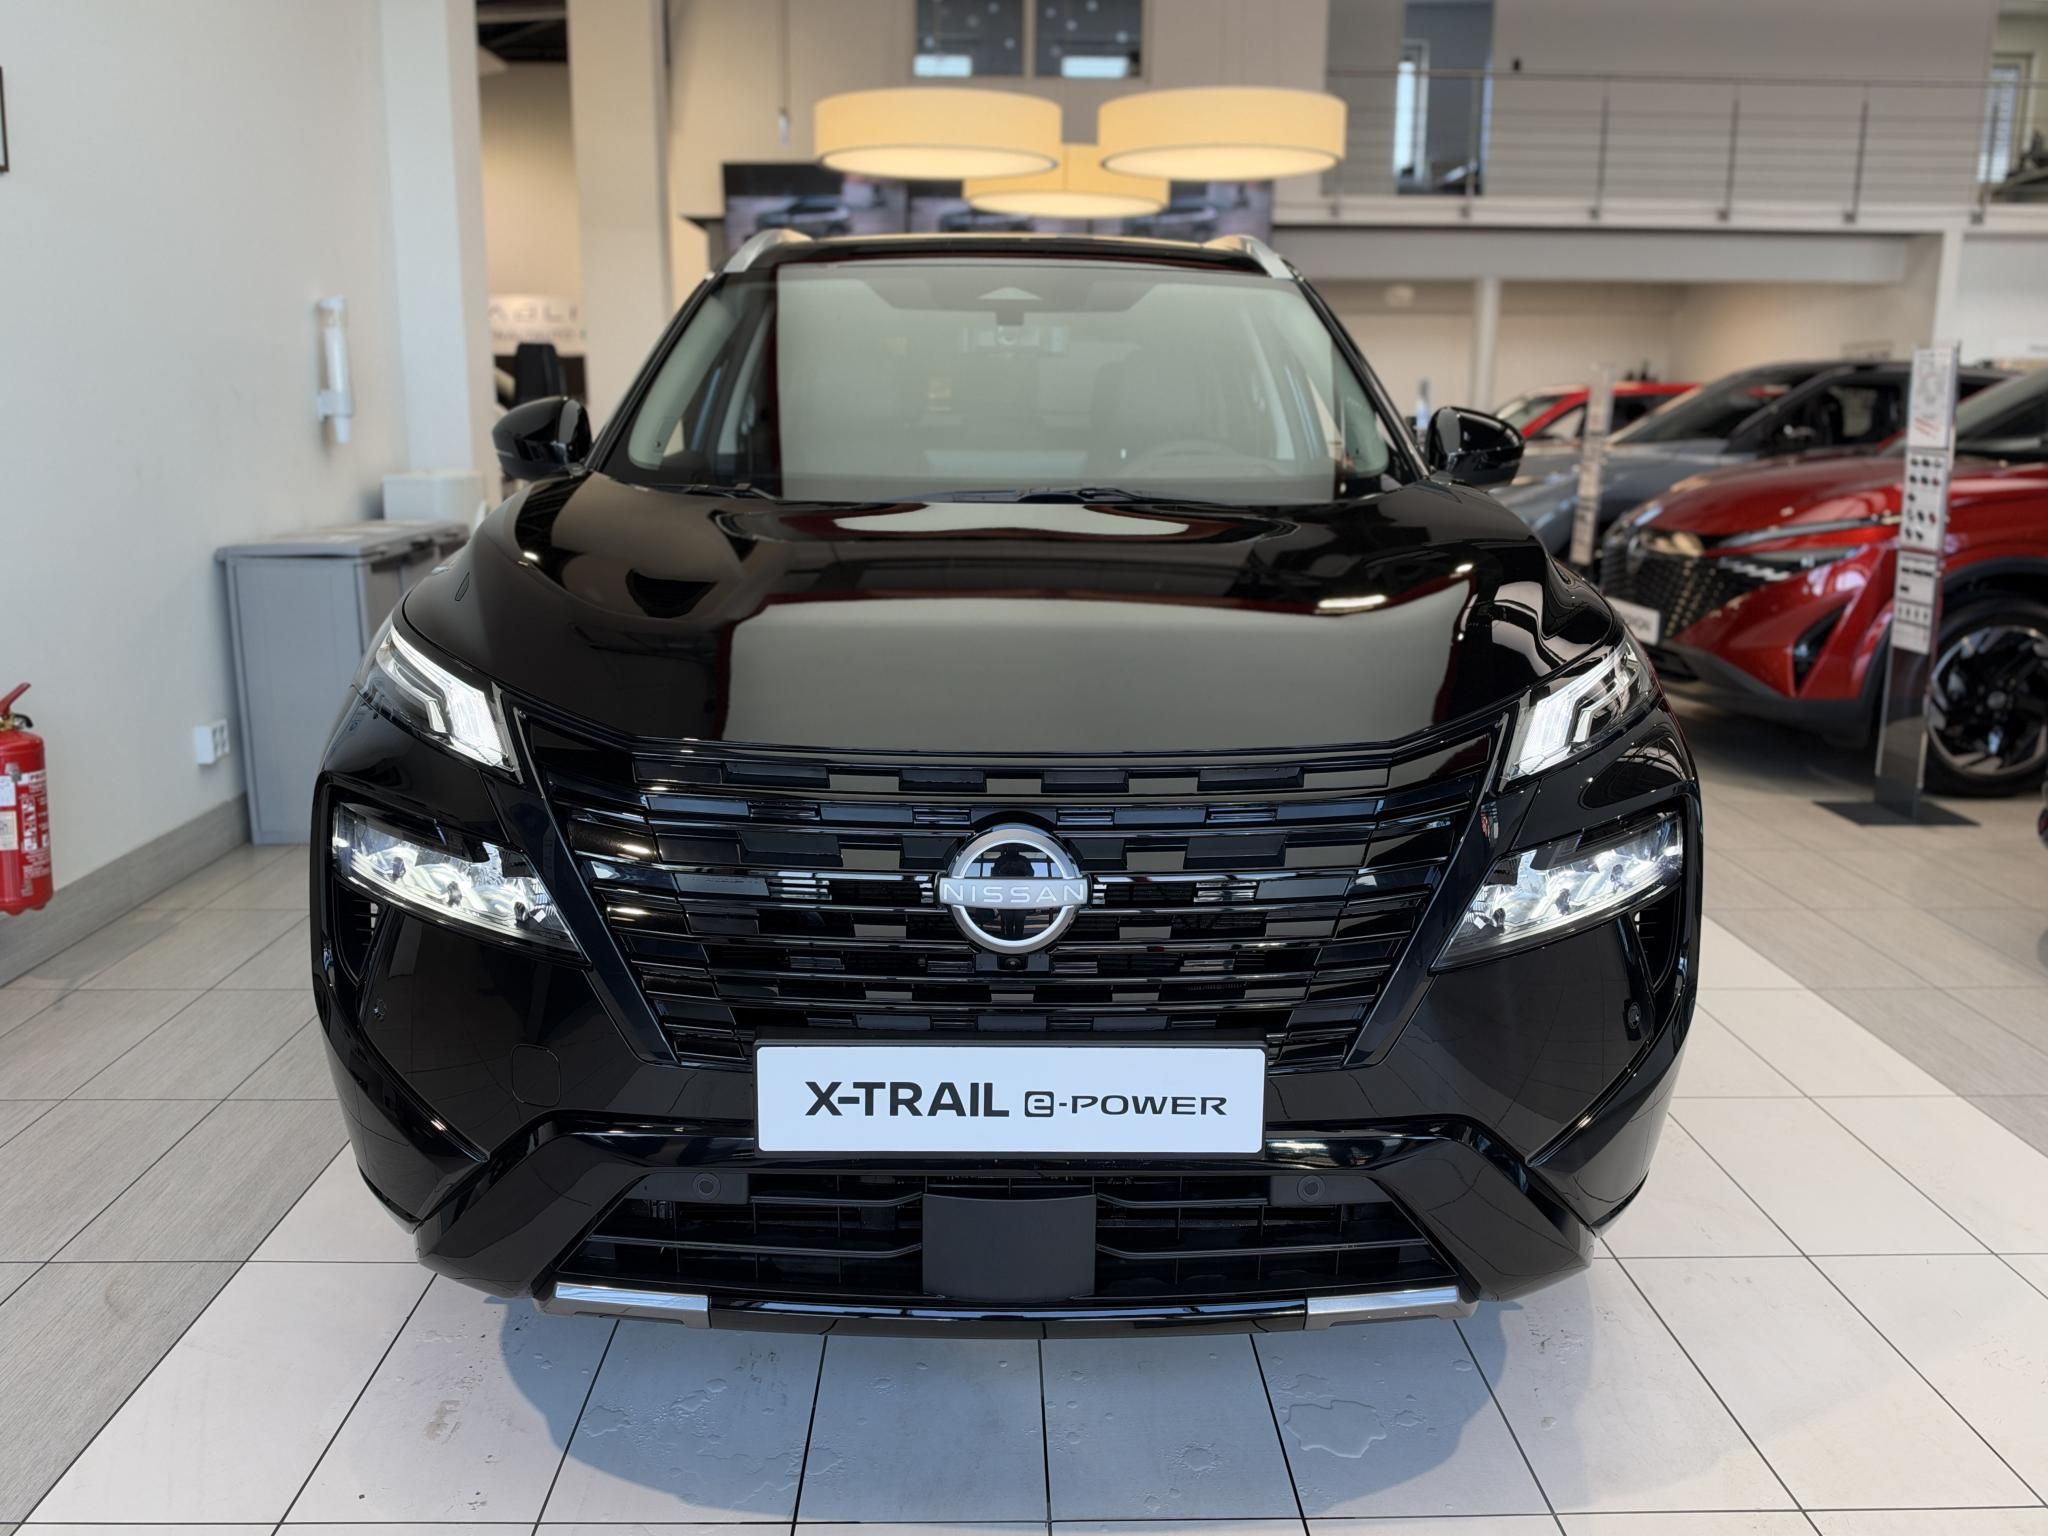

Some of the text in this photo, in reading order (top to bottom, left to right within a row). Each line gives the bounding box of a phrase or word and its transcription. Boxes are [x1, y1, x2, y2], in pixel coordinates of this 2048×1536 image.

[943, 883, 1085, 903] NISSAN
[805, 1081, 1228, 1118] X-TRAIL e-POWER
